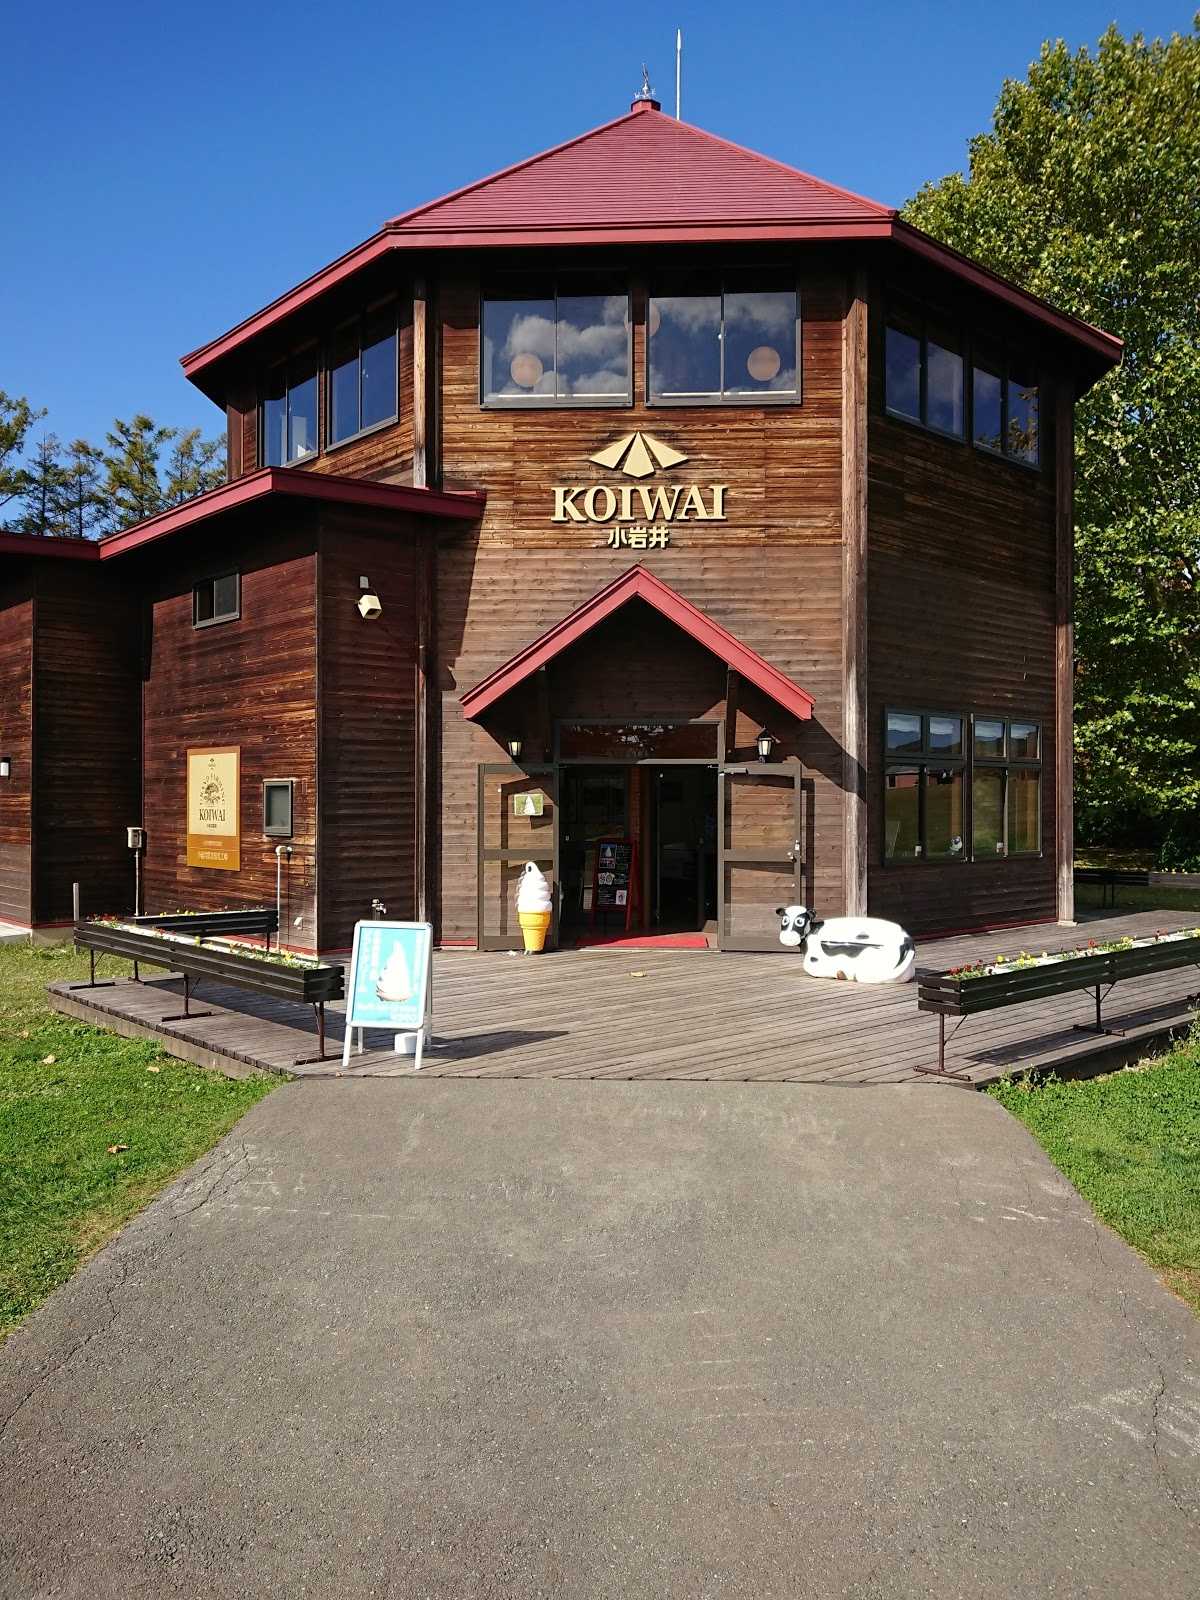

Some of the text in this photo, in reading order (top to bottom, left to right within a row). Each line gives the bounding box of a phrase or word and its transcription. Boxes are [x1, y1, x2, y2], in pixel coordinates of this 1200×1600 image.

[551, 485, 728, 522] KOIWAI
[608, 526, 670, 549] 小岩井
[199, 808, 226, 822] KOIWAI
